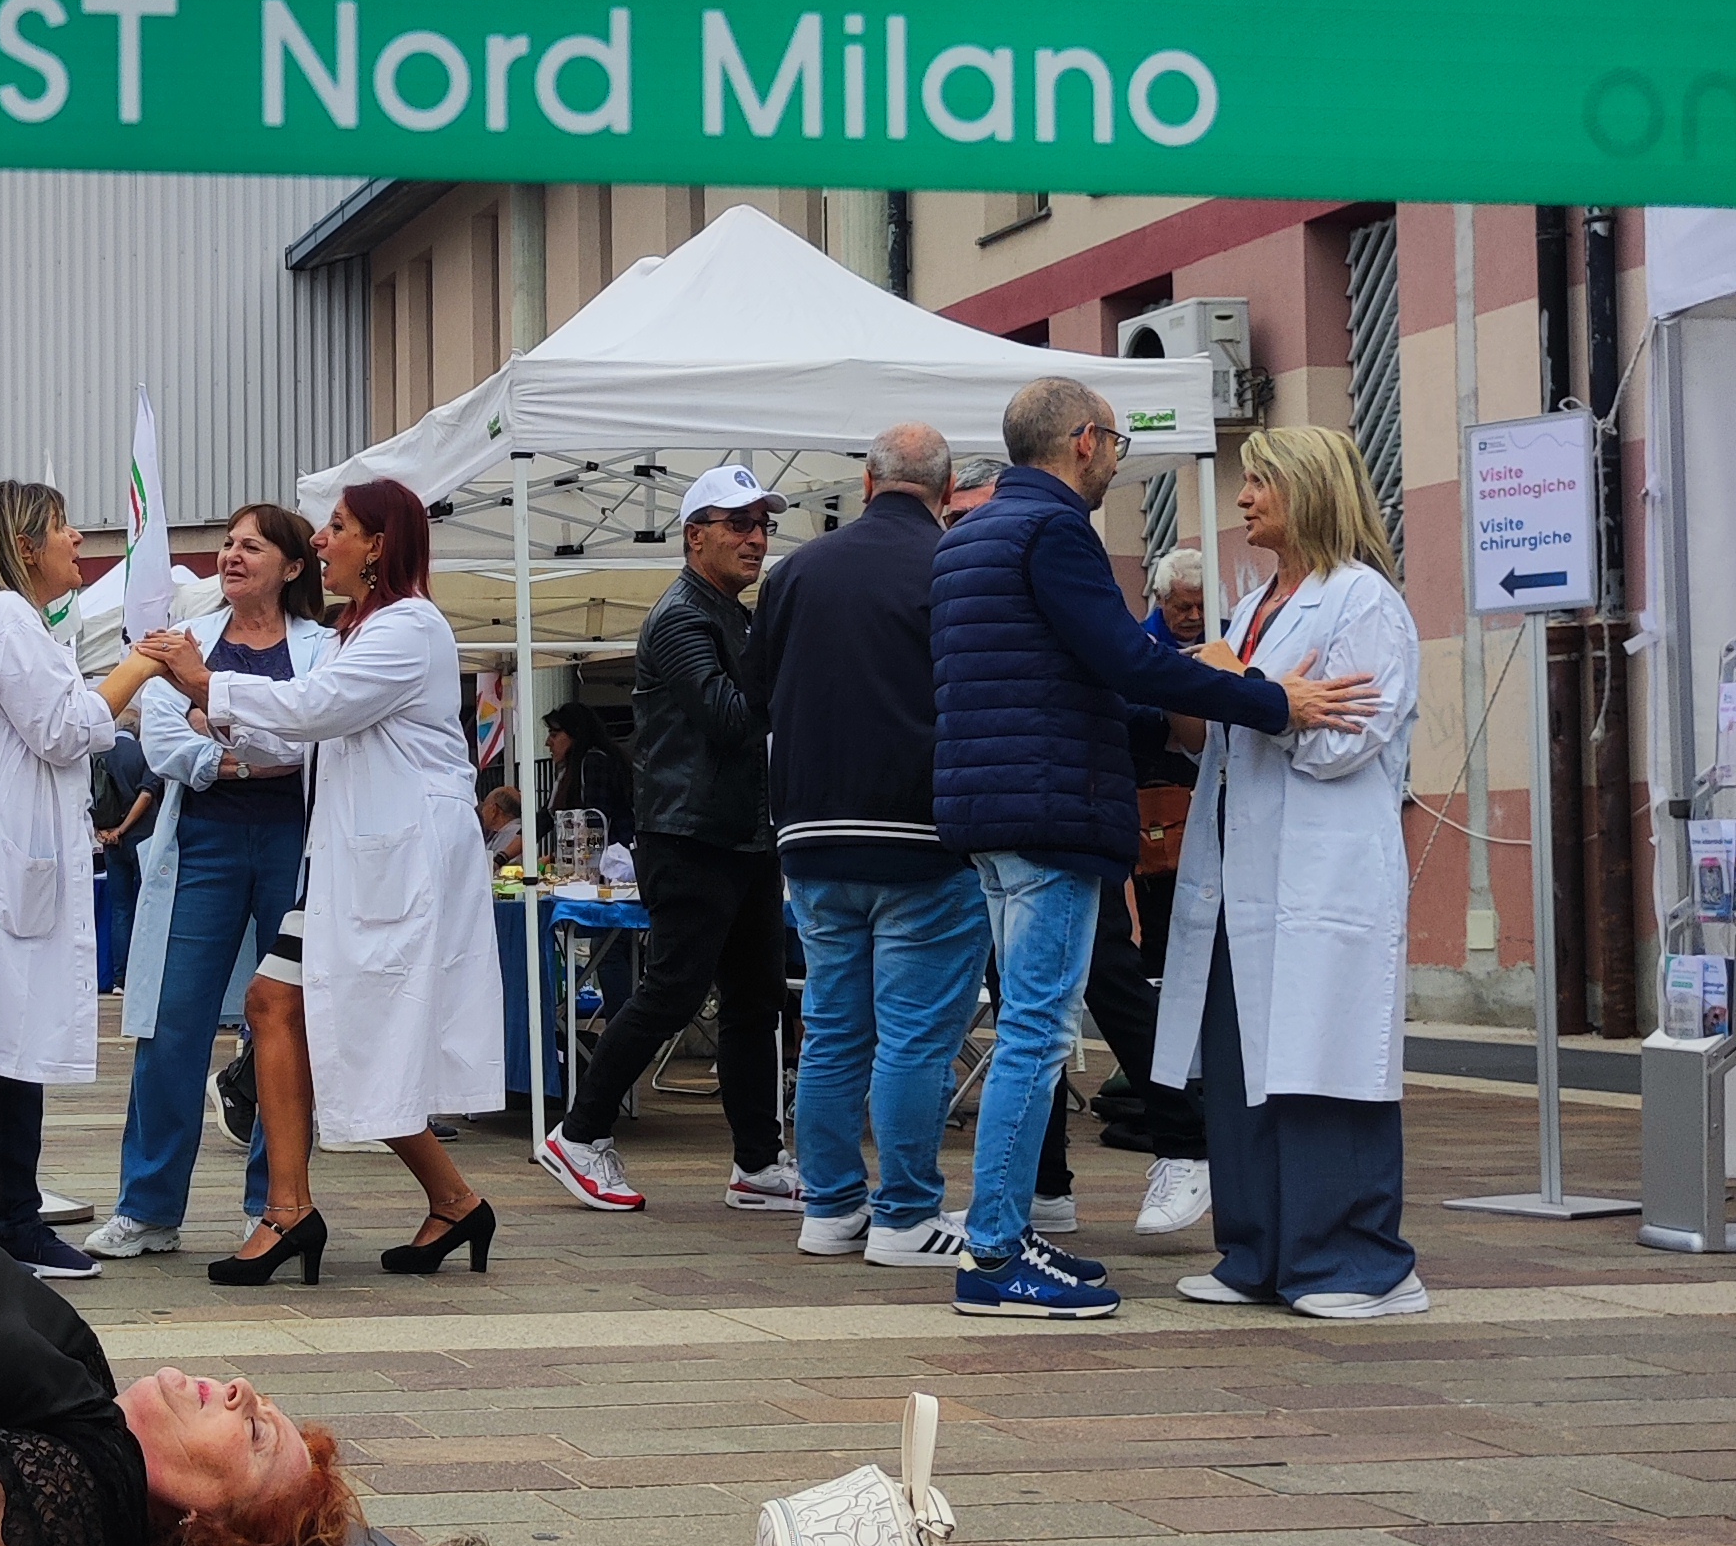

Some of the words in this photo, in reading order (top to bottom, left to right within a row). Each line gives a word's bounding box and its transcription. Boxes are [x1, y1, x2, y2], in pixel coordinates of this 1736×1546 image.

[700, 7, 1220, 148] Milano
[1478, 465, 1524, 484] Visite
[1478, 477, 1577, 500] senologiche
[1479, 516, 1525, 534] Visite
[1479, 530, 1573, 552] chirurgiche
